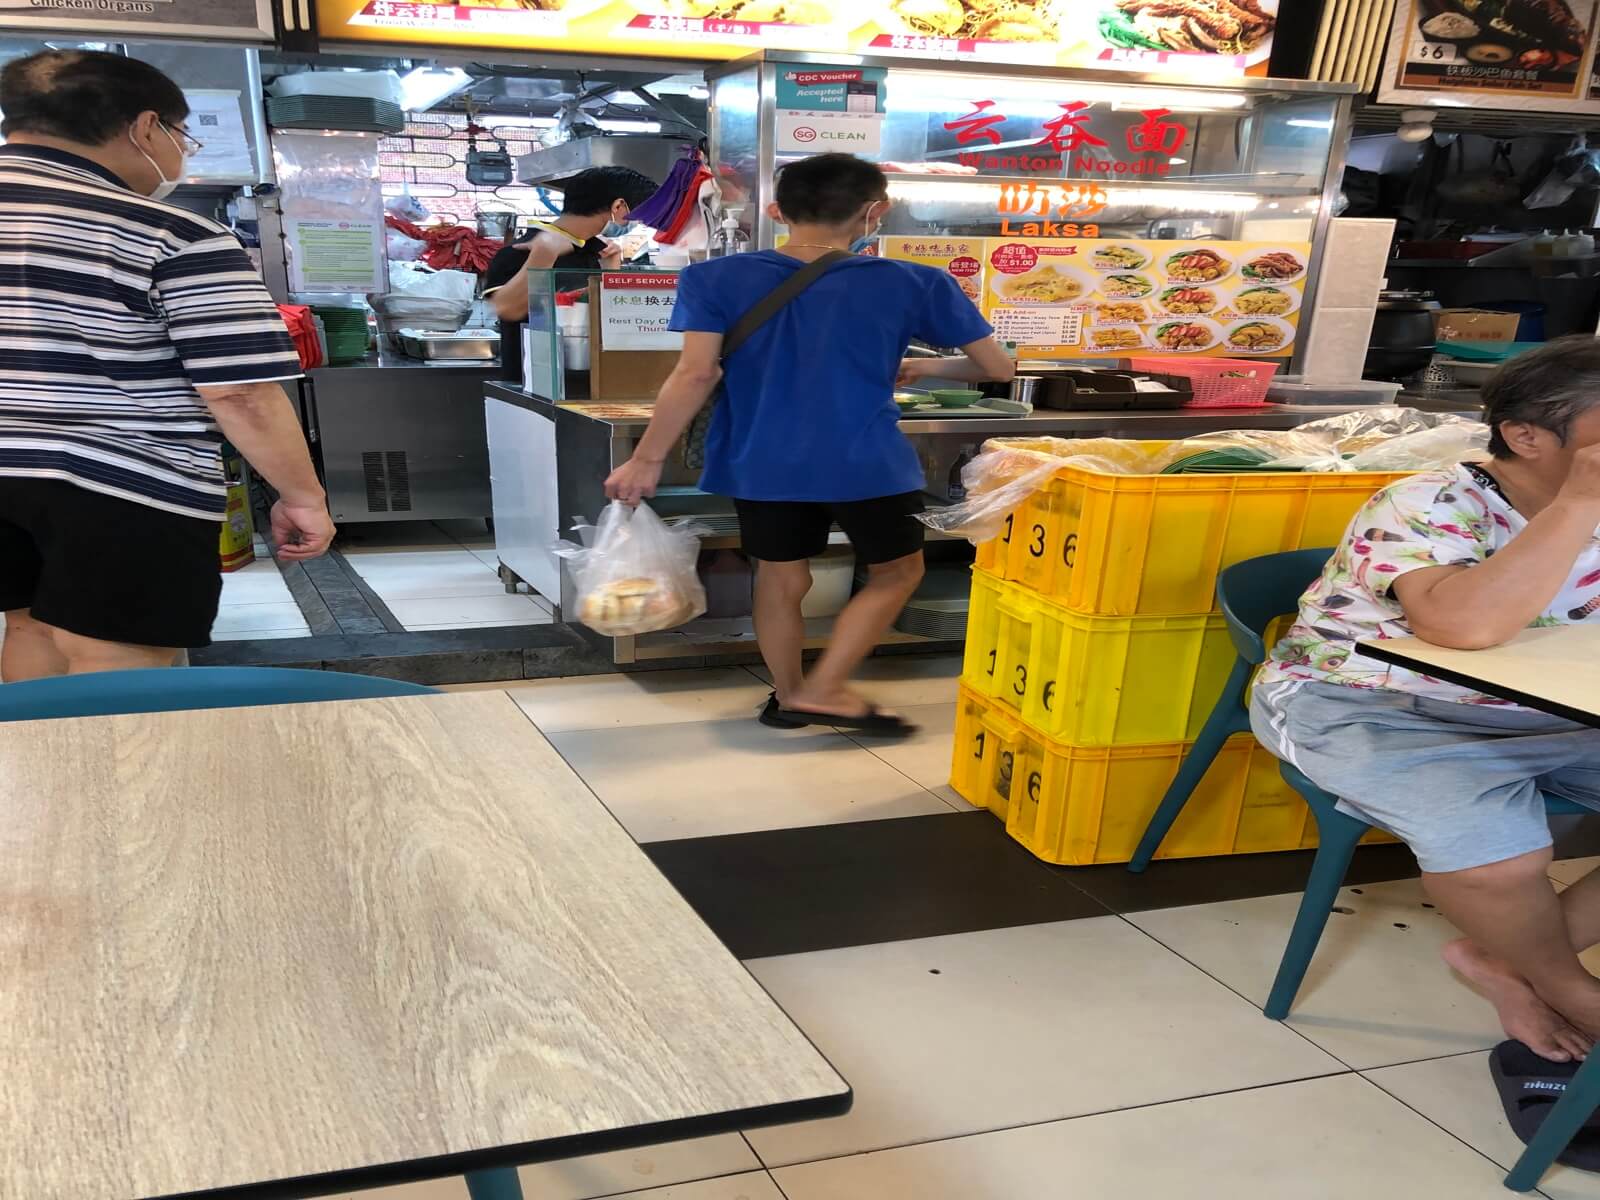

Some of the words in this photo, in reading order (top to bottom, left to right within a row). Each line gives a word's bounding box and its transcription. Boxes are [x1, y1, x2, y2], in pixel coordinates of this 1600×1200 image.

[99, 0, 153, 13] Organs
[1420, 45, 1444, 60] $6
[820, 73, 857, 81] Voucher
[796, 88, 844, 96] Accepted
[796, 130, 813, 139] SG
[820, 131, 866, 141] CLEAN
[958, 152, 1063, 171] Wanton
[1075, 156, 1172, 176] Noodle
[1001, 219, 1101, 238] Laksa
[635, 318, 655, 326] Day
